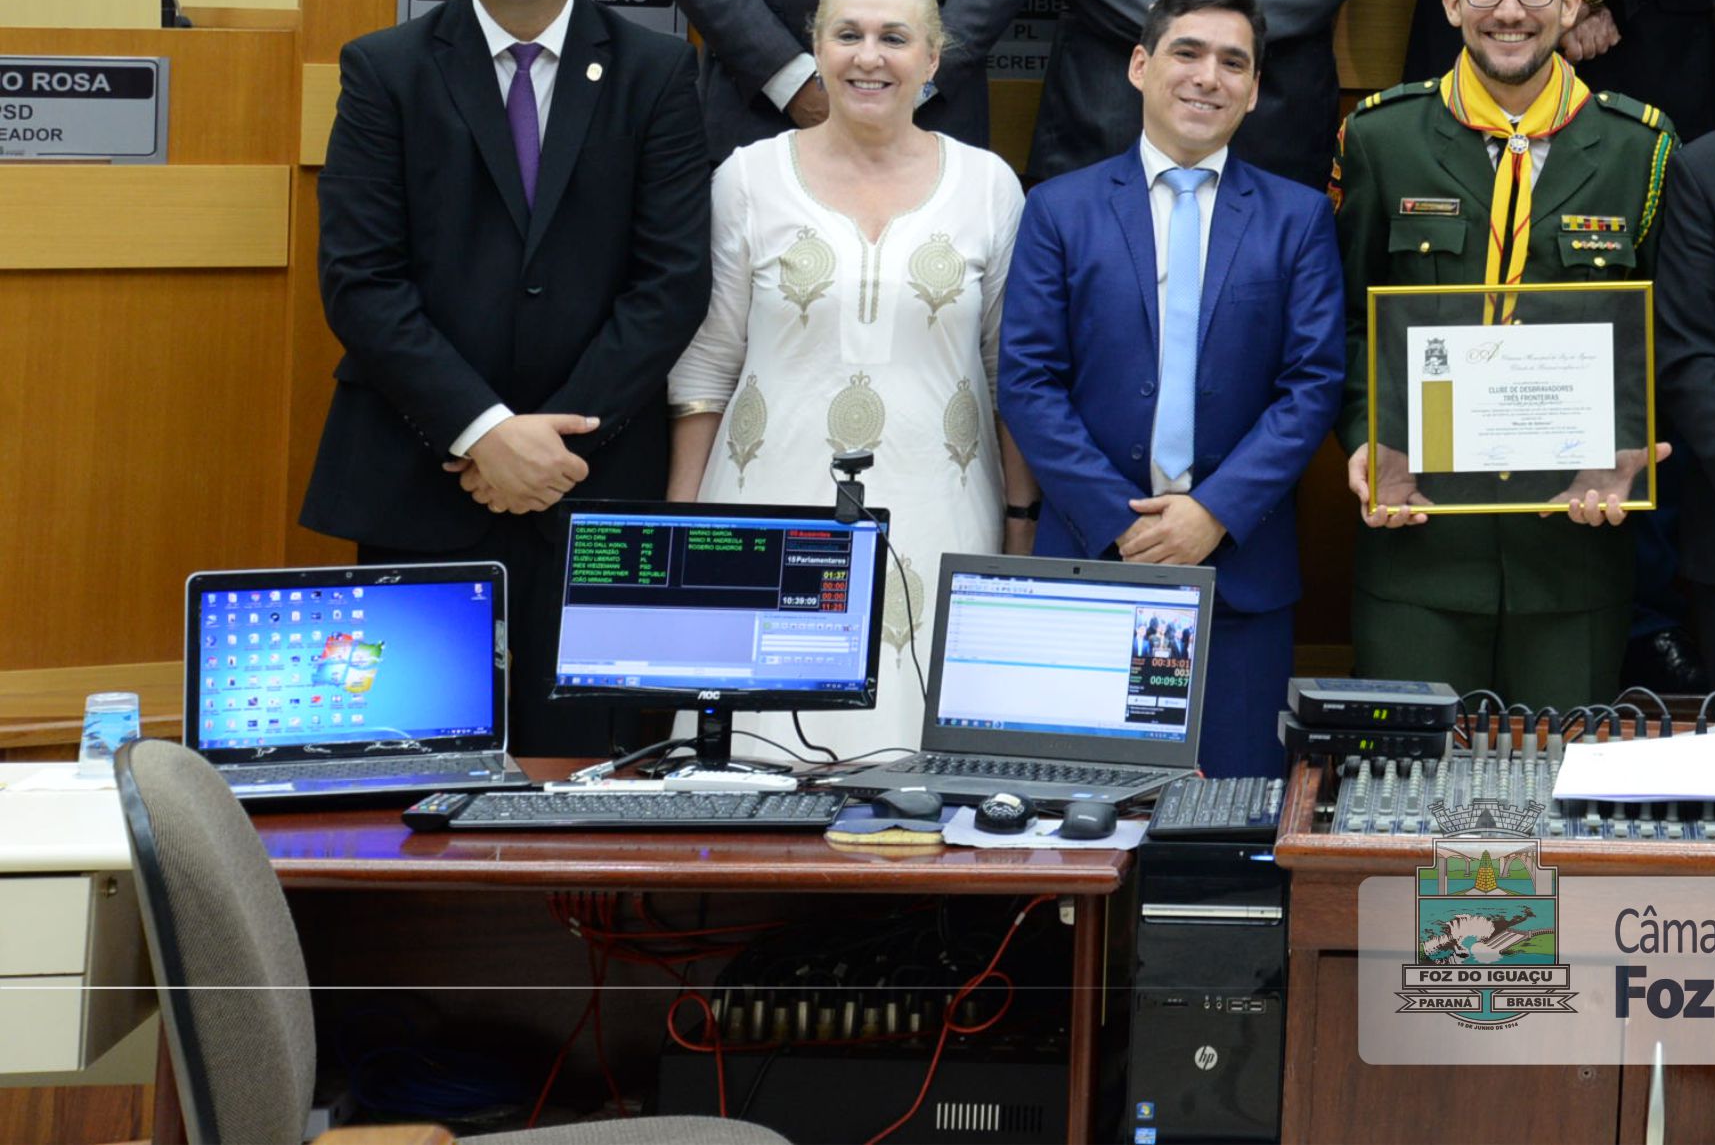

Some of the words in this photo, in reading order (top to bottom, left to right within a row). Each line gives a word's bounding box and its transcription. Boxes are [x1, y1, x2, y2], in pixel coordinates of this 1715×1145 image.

[1014, 24, 1039, 39] PL
[0, 71, 24, 91] O
[32, 72, 112, 92] ROSA
[0, 104, 33, 121] SD
